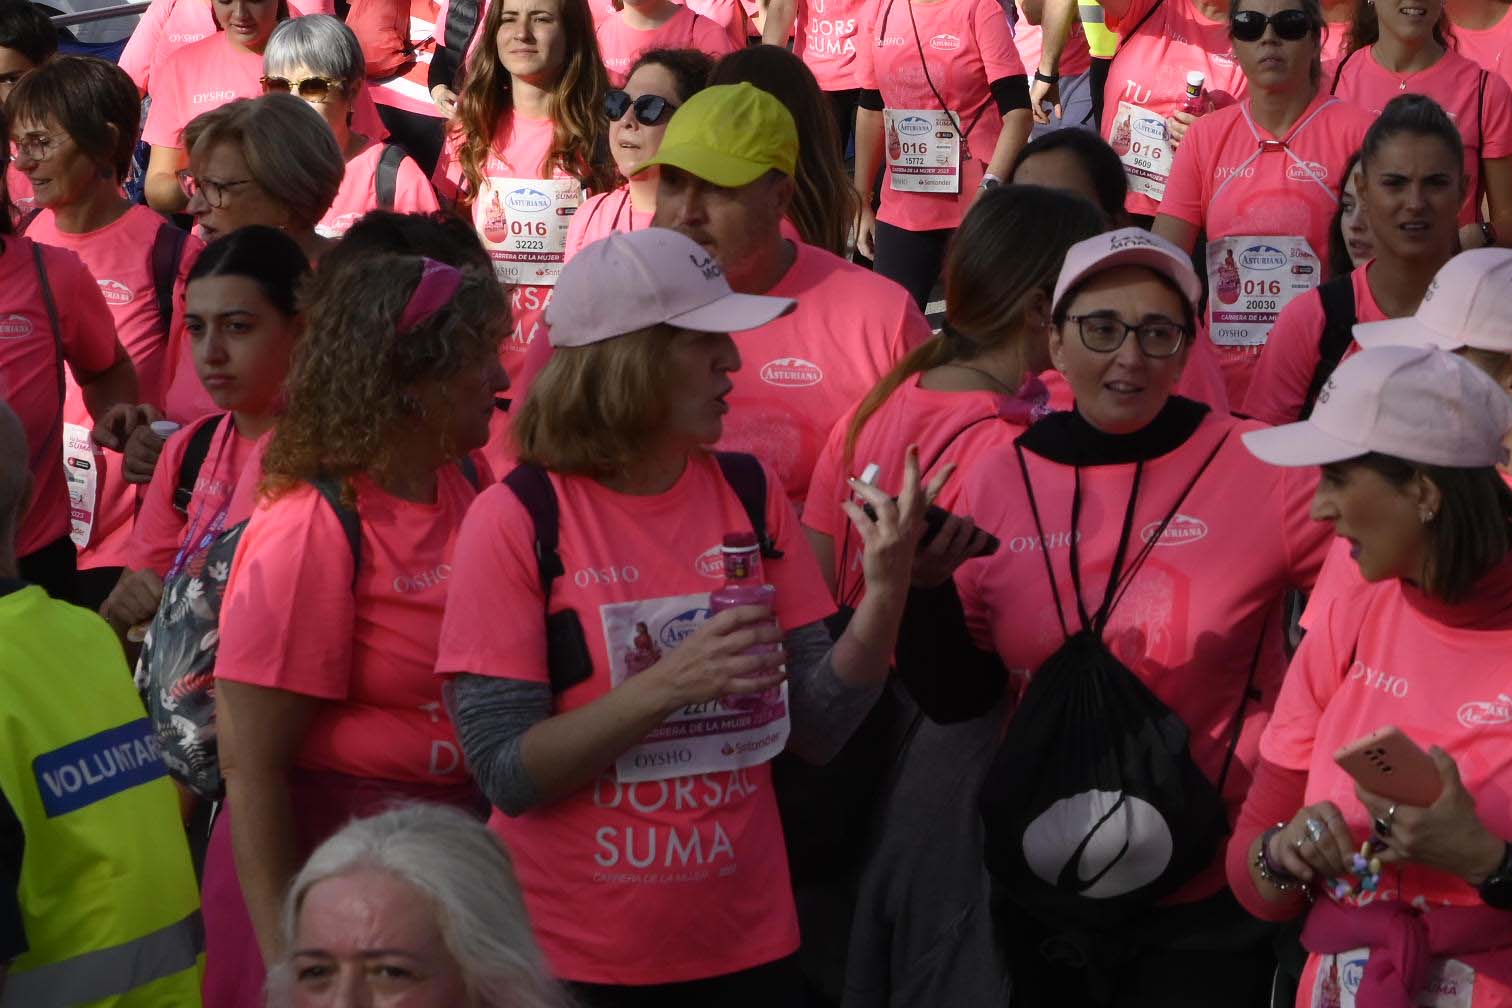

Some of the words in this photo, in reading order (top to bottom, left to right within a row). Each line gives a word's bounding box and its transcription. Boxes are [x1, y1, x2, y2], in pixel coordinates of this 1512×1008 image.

[1126, 79, 1153, 104] TU
[902, 142, 928, 154] 016
[1132, 142, 1162, 159] 016
[905, 157, 924, 165] 15772
[510, 221, 548, 236] 016
[515, 240, 544, 250] 32223
[1241, 256, 1284, 266] ASTURIANA
[1244, 280, 1281, 295] 016
[1246, 300, 1276, 310] 20030
[765, 366, 818, 382] ASTURIANA
[42, 733, 162, 798] VOLUNTAR
[634, 750, 693, 768] OYSHO
[594, 821, 736, 868] SUMA
